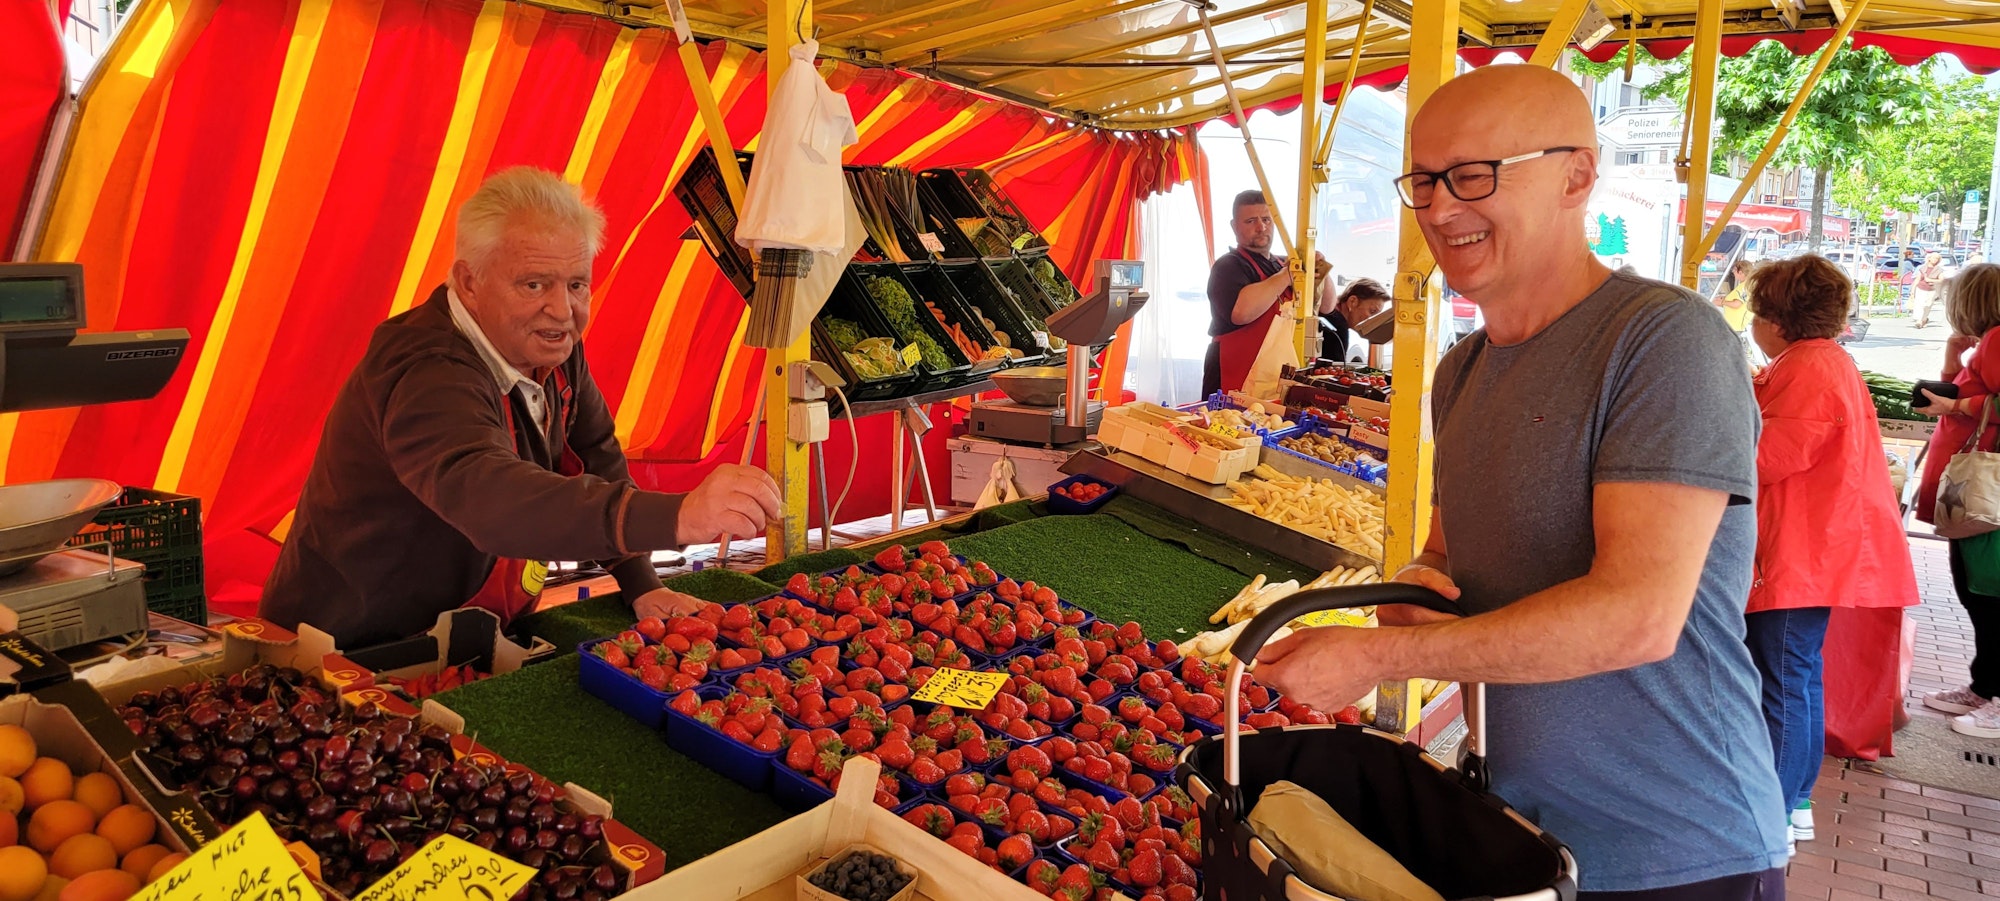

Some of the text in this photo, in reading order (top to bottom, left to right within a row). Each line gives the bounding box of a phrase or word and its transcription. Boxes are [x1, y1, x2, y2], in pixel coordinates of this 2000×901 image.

[1628, 118, 1659, 127] Polizei
[107, 347, 178, 361] BIZERBA
[1352, 429, 1369, 440] Tasty
